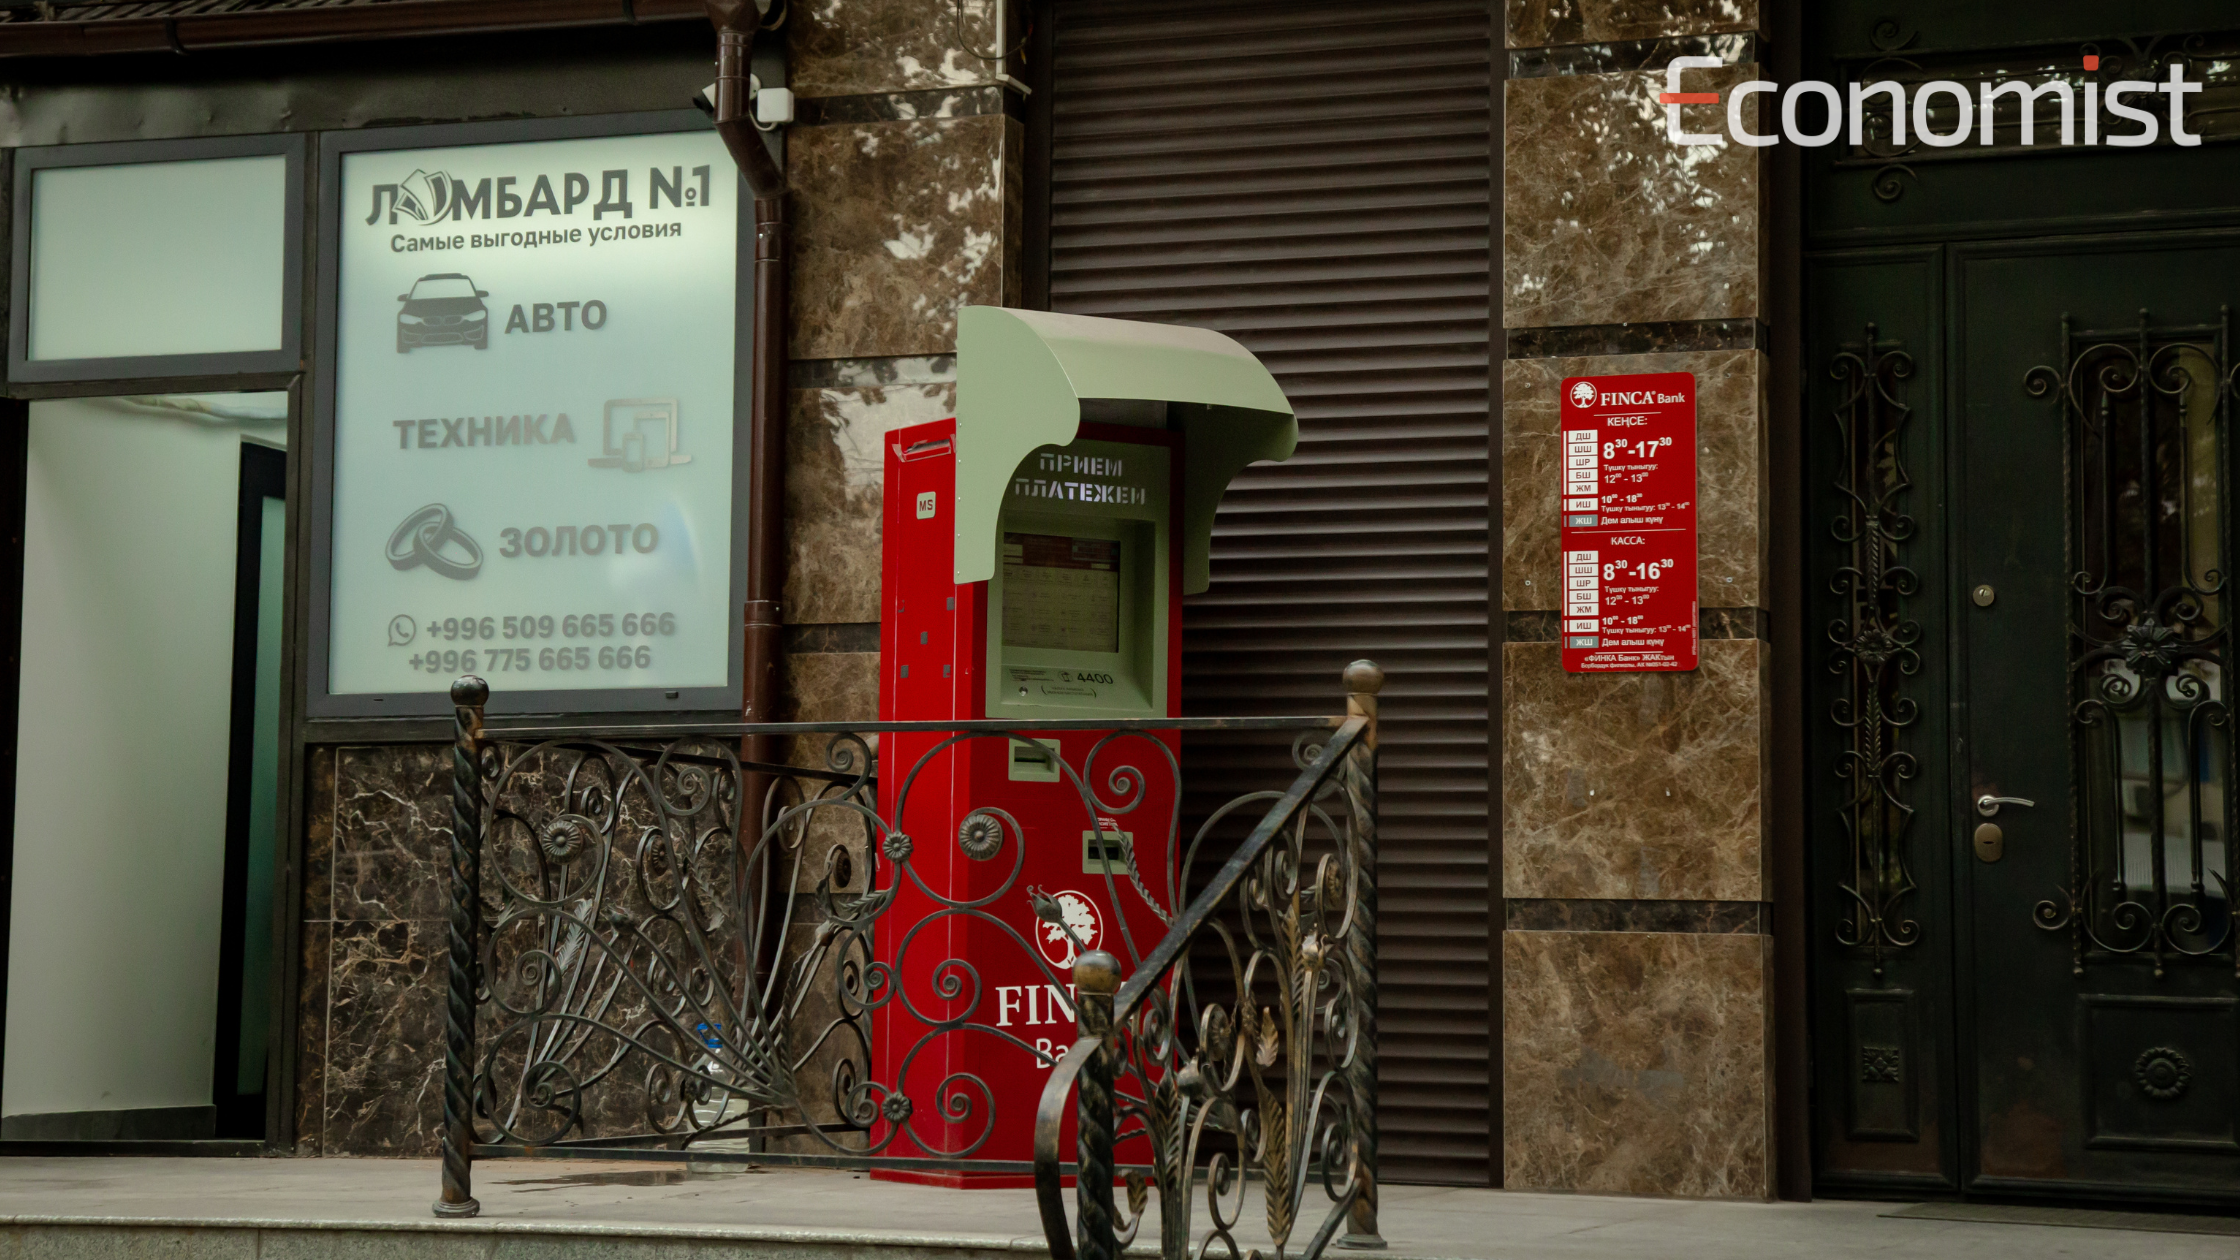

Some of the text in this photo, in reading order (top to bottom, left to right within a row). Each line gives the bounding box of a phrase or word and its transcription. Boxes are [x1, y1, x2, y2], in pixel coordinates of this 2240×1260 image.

[649, 164, 711, 210] №1
[390, 222, 682, 254] Самые выгодные условия
[504, 299, 607, 335] АВТО
[1657, 393, 1685, 404] Bank
[392, 413, 577, 450] ТЕХНИКА
[1575, 433, 1591, 441] ДШ
[1574, 445, 1592, 453] ШШ
[1040, 452, 1123, 477] ПРИЕМ
[919, 499, 934, 512] MS
[1575, 517, 1592, 525] ЖШ
[498, 523, 660, 559] ЗОЛОТО
[1611, 536, 1645, 545] КАССА:
[1576, 553, 1591, 562] ДШ
[1575, 566, 1592, 574] ШШ
[1576, 579, 1591, 587] ШР
[1576, 592, 1591, 600] БШ
[1576, 605, 1592, 613] ЖМ
[426, 611, 677, 641] +996 509 665 666
[1575, 638, 1593, 646] ЖШ
[408, 645, 652, 674] +996 775 665 666
[1077, 672, 1114, 685] 4400
